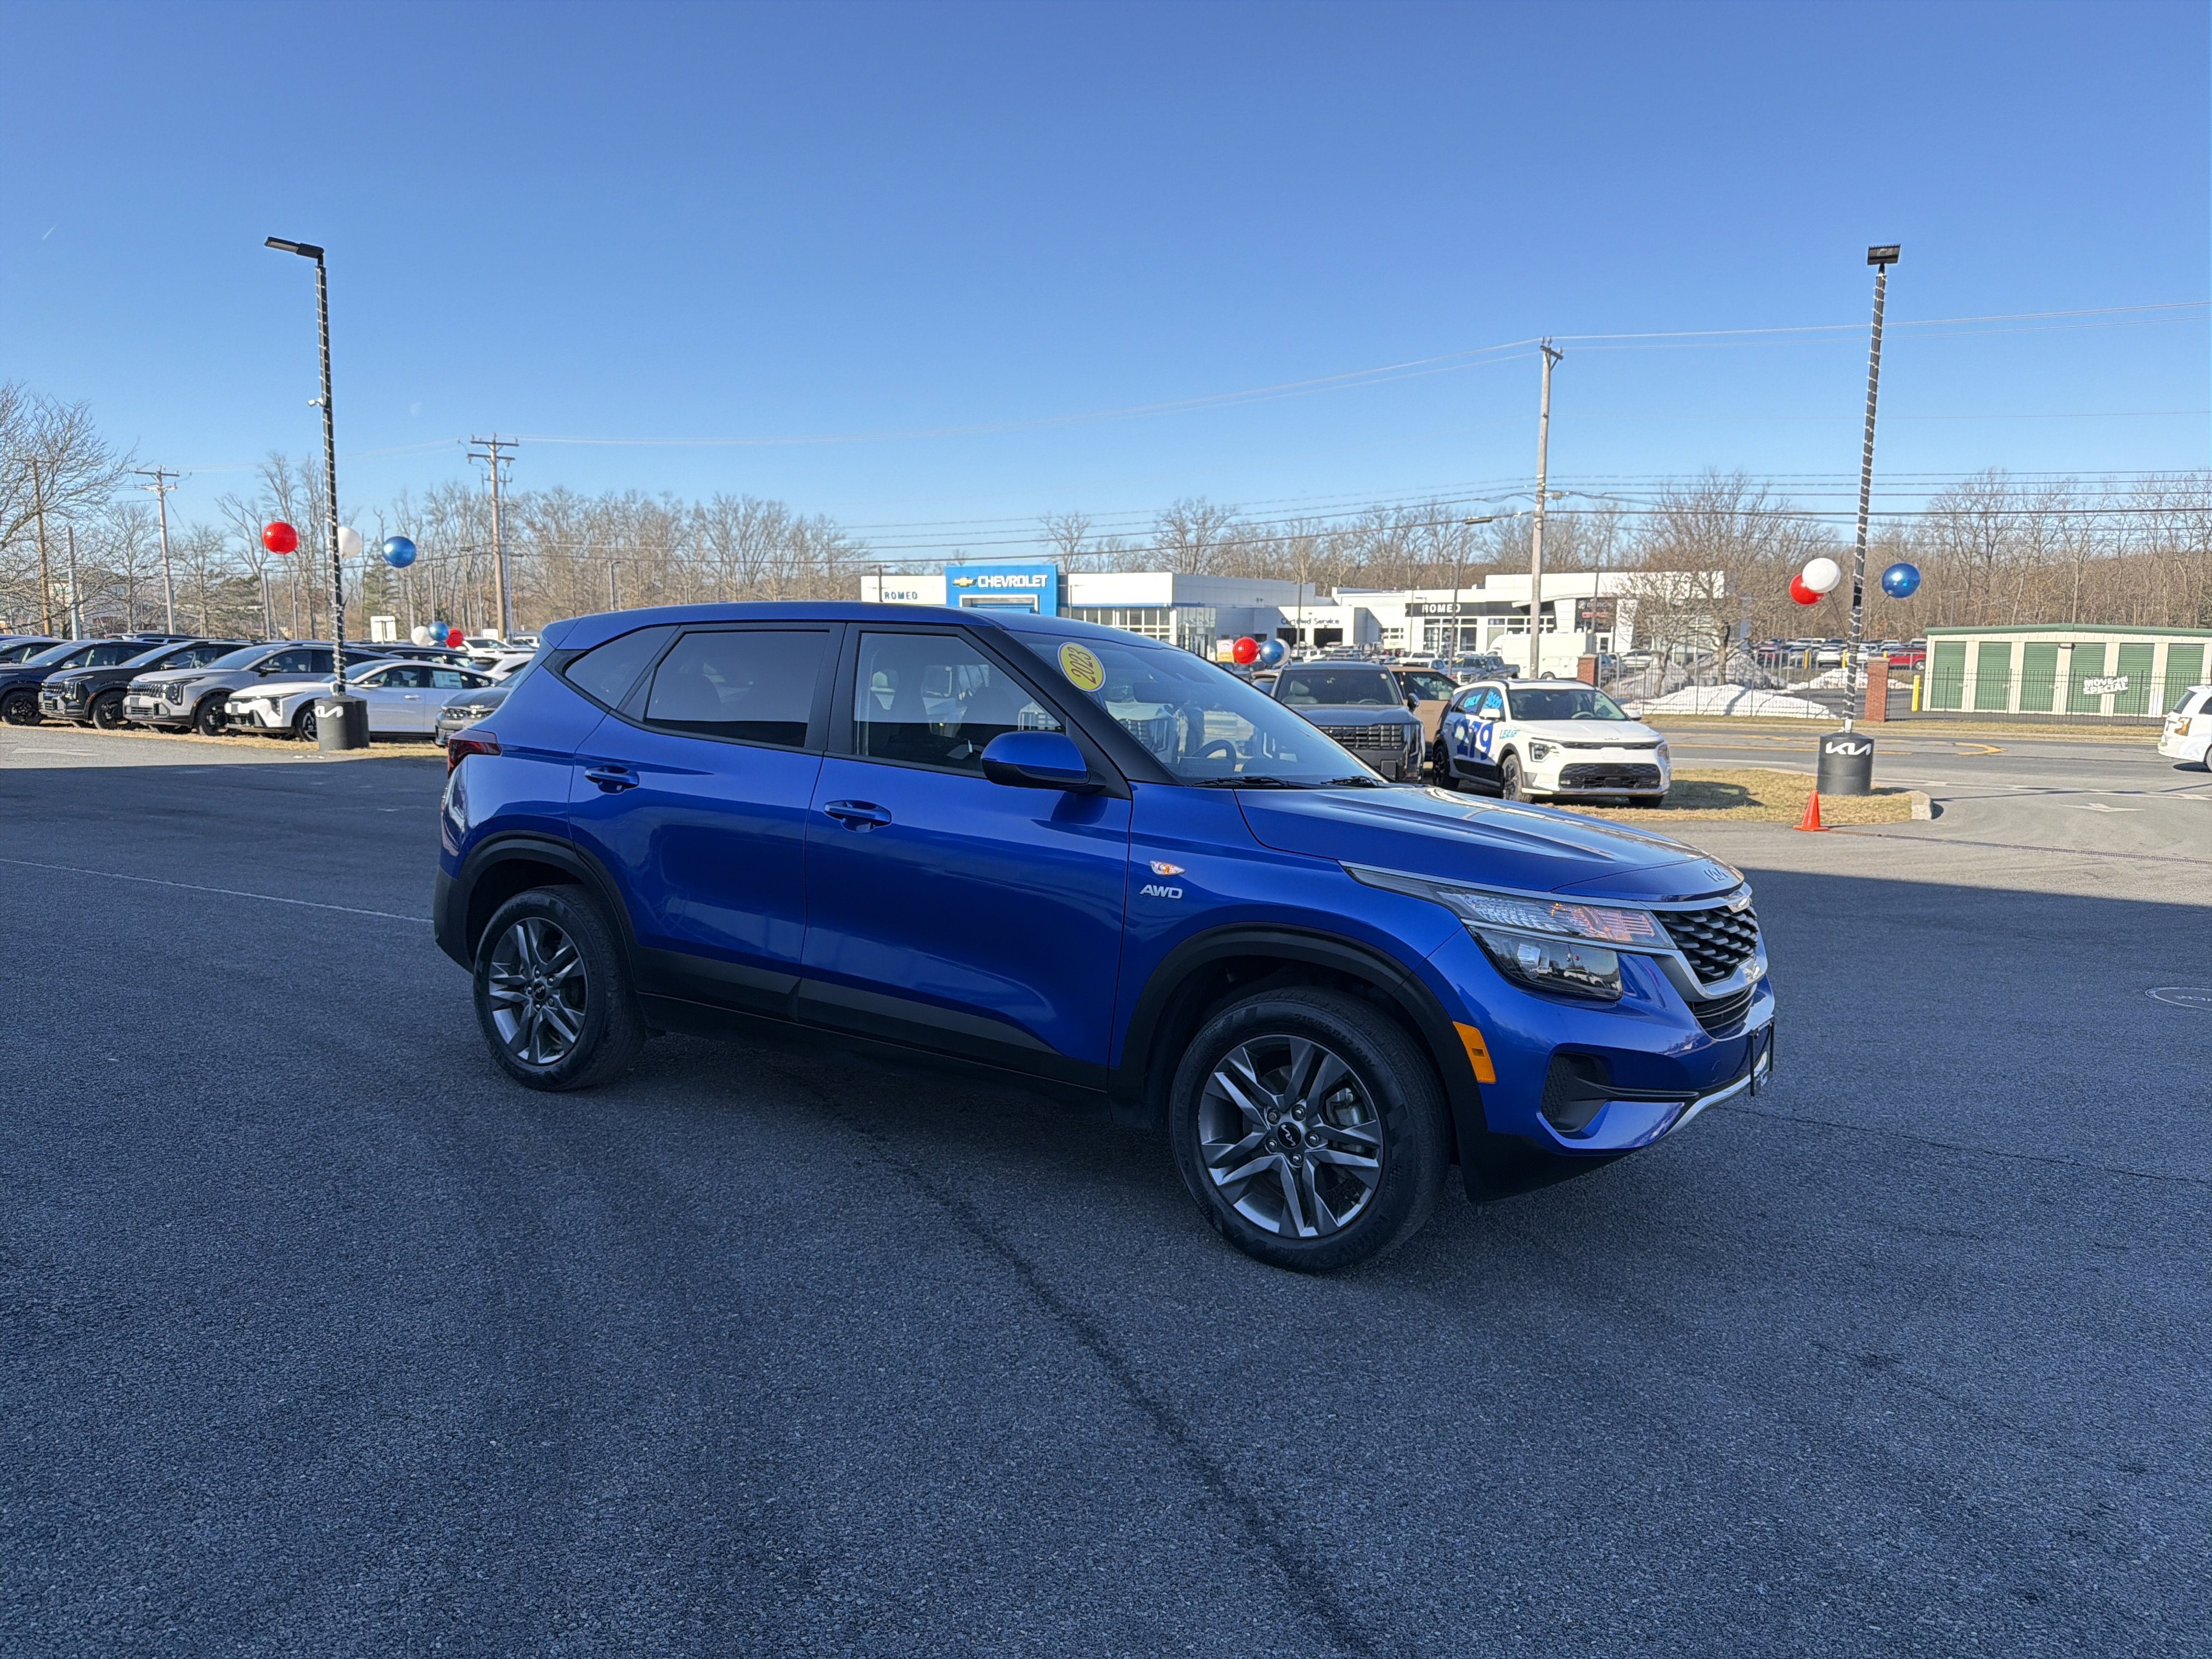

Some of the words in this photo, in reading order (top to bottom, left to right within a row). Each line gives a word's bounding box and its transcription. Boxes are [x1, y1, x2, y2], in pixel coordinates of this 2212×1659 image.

[978, 575, 1047, 588] CHEVROLET
[884, 591, 918, 600] ROMEO
[1422, 604, 1462, 613] ROMEO
[1066, 646, 1097, 685] 2023
[2083, 682, 2128, 694] SPECIAL
[1825, 741, 1871, 756] KIA
[1139, 884, 1183, 899] AWD
